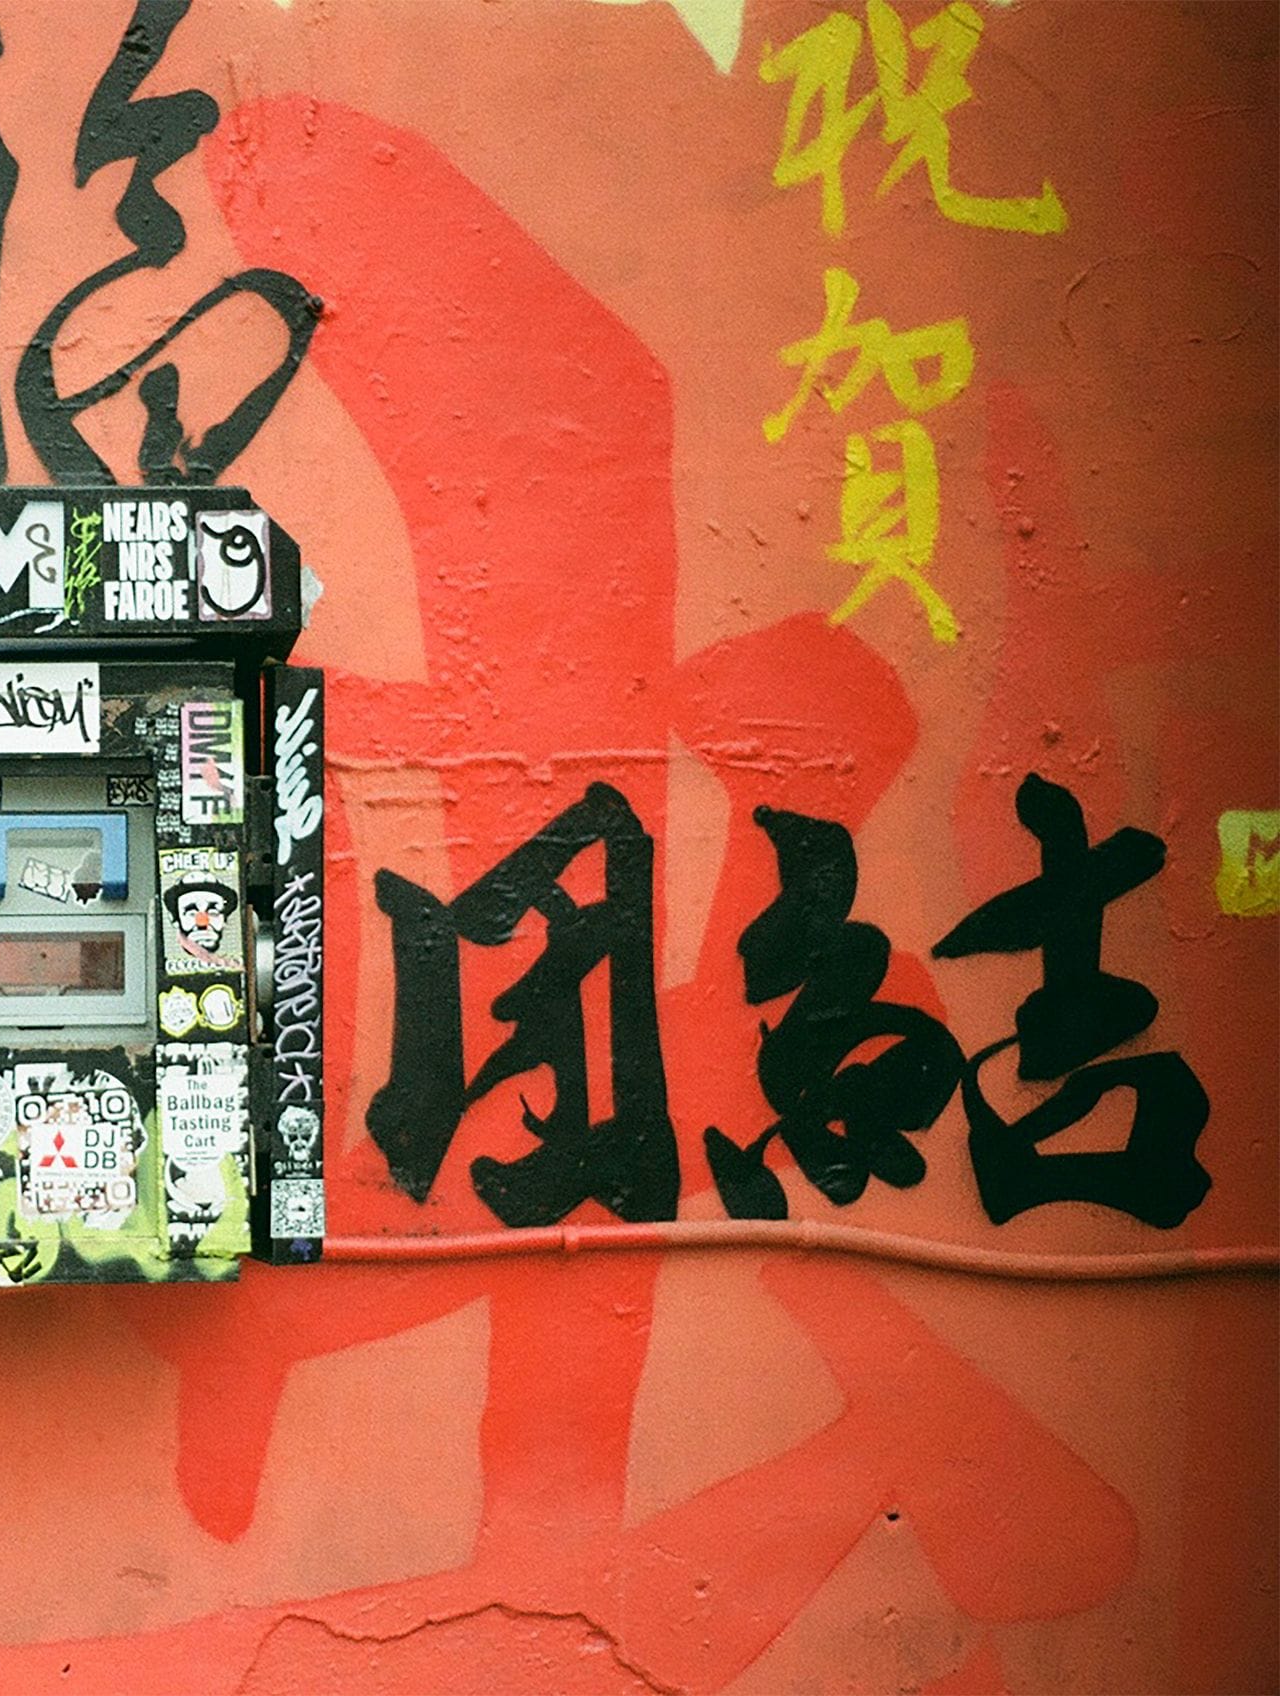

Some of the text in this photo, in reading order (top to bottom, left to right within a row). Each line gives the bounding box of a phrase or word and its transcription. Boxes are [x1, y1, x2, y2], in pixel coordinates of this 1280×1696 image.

[103, 501, 189, 543] NEARS
[118, 541, 175, 582] NRS
[103, 580, 190, 621] FAROE
[163, 851, 209, 873] CHEER
[186, 1079, 208, 1090] The
[167, 1095, 236, 1112] Ballbag
[170, 1114, 232, 1132] Tasting
[85, 1130, 116, 1148] DJ
[184, 1134, 217, 1147] Cart
[84, 1150, 118, 1169] DB
